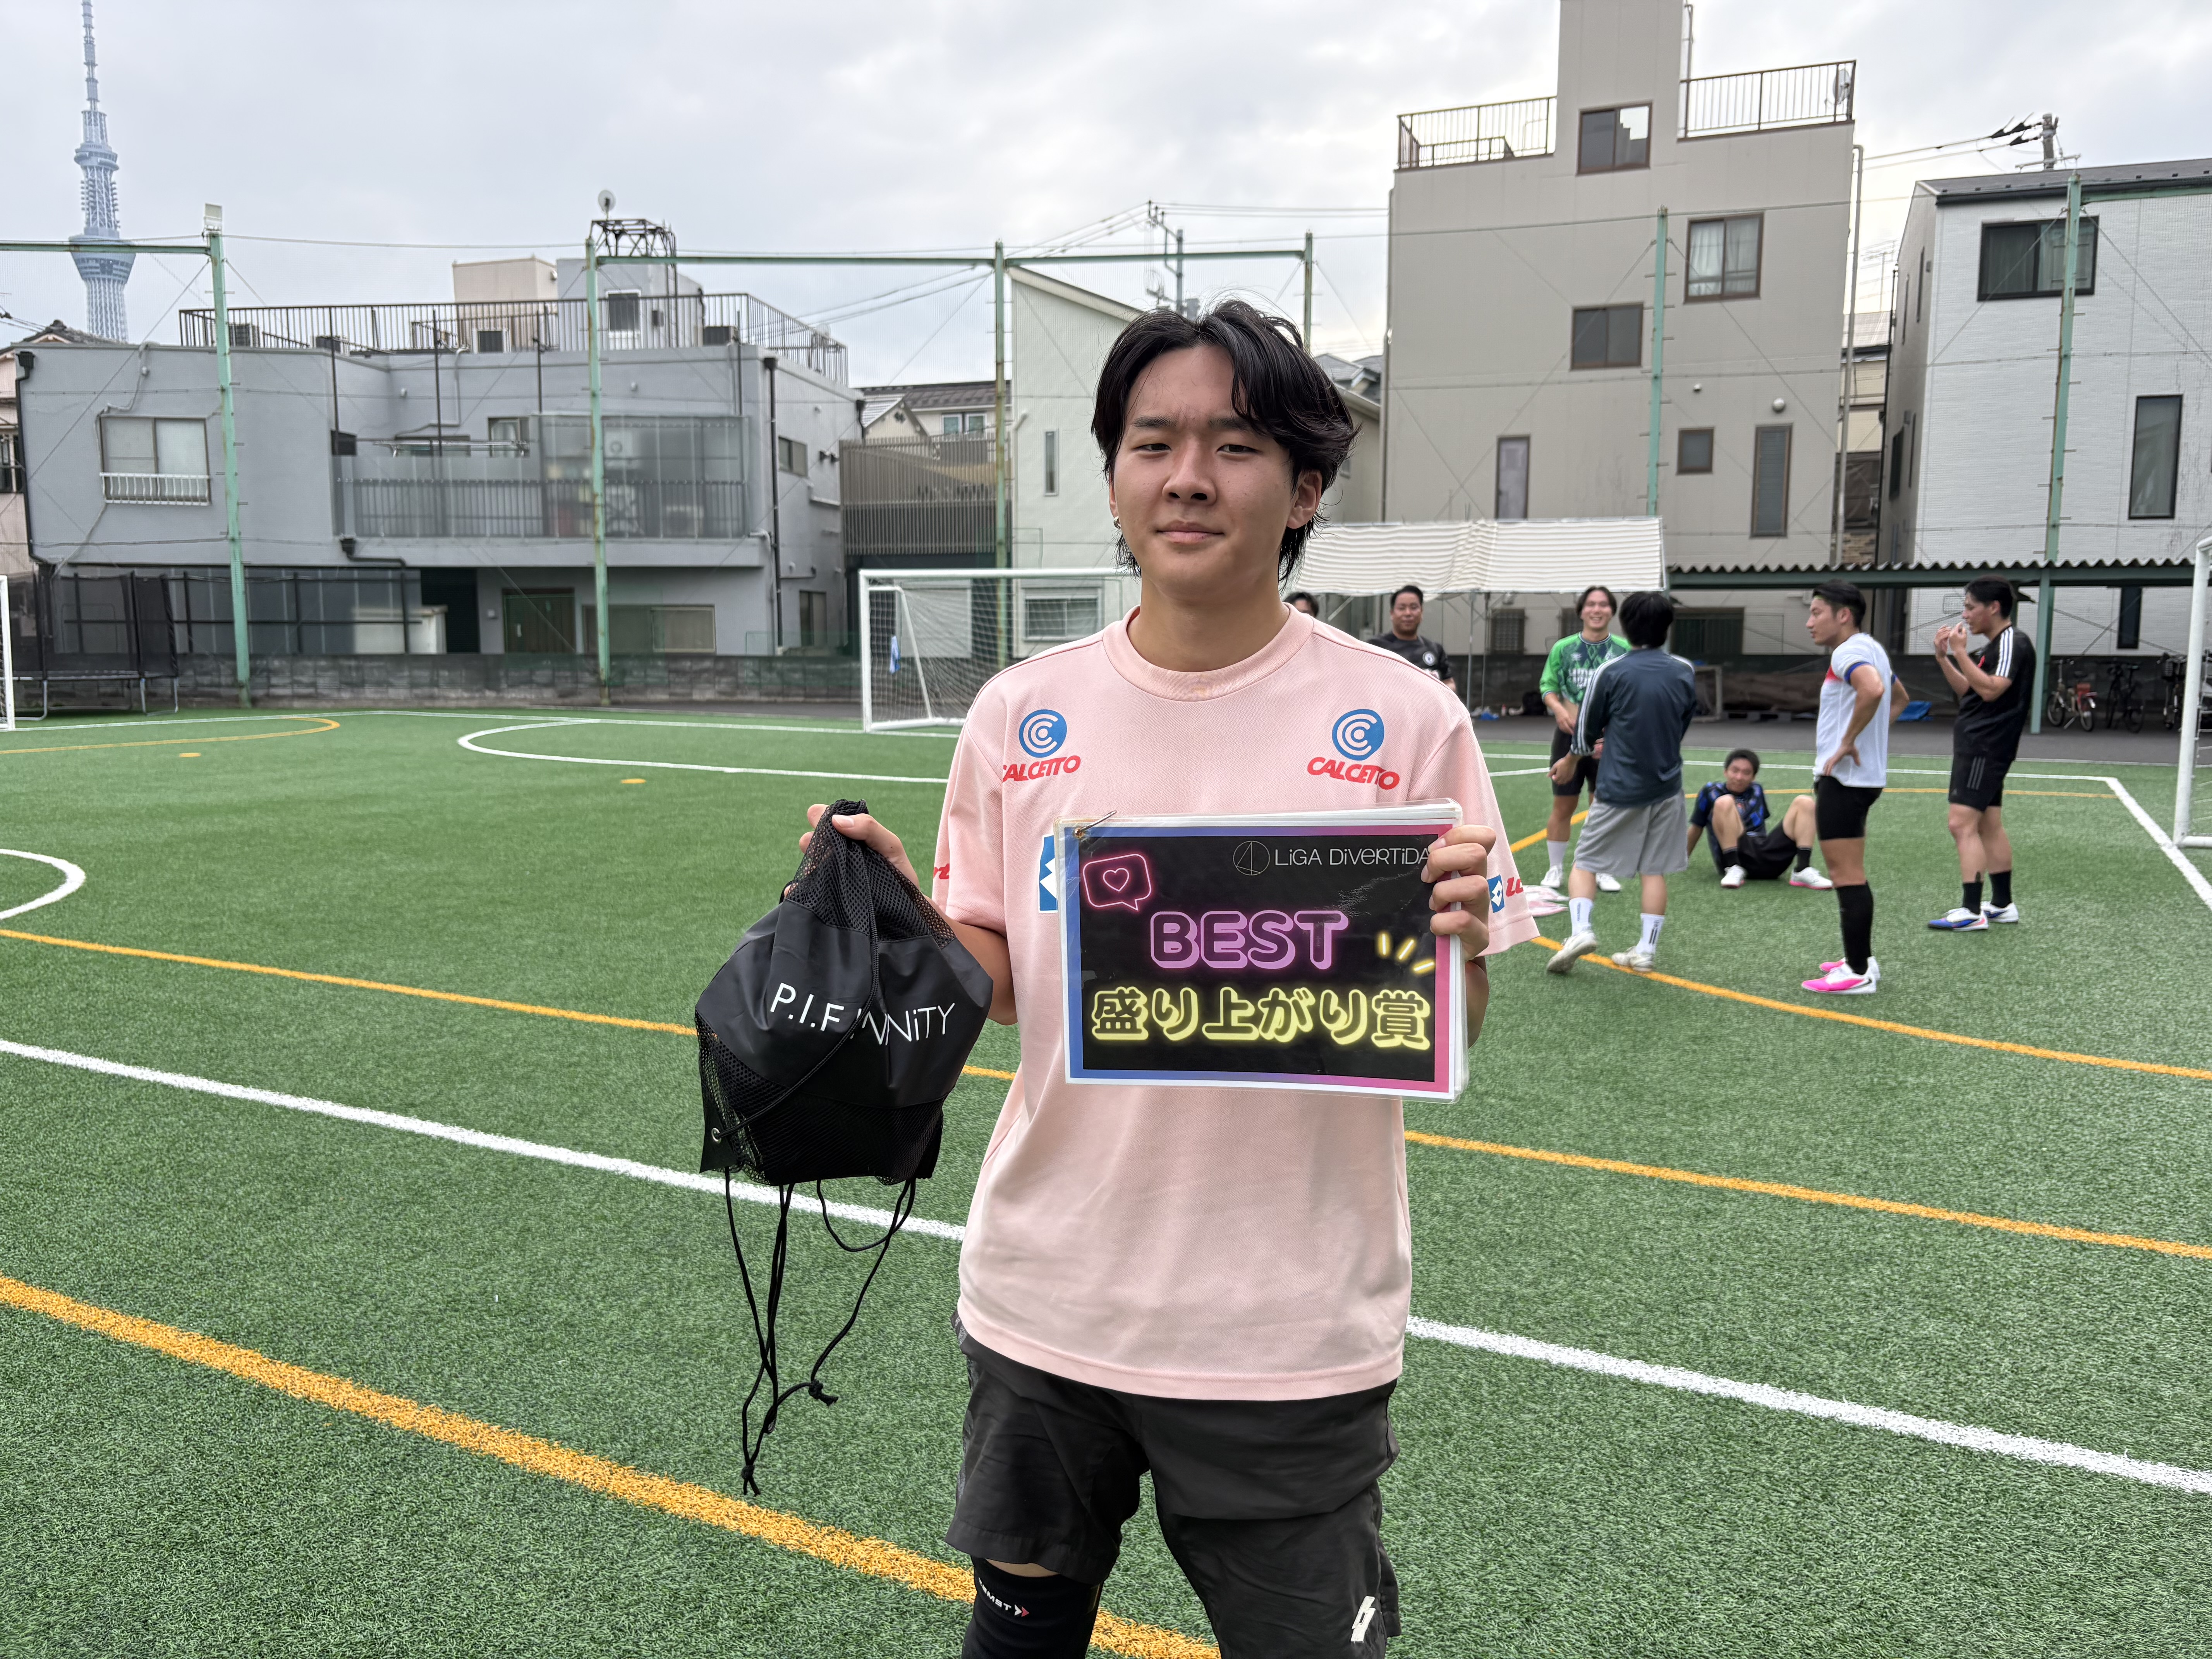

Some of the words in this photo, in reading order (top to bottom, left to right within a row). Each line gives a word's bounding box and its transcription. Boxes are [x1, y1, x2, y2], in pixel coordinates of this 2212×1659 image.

[1002, 755, 1081, 783] ALCETTO
[1307, 756, 1400, 790] CALCETTO
[1151, 910, 1349, 969] BEST
[1092, 986, 1431, 1050] 盛り上がり賞
